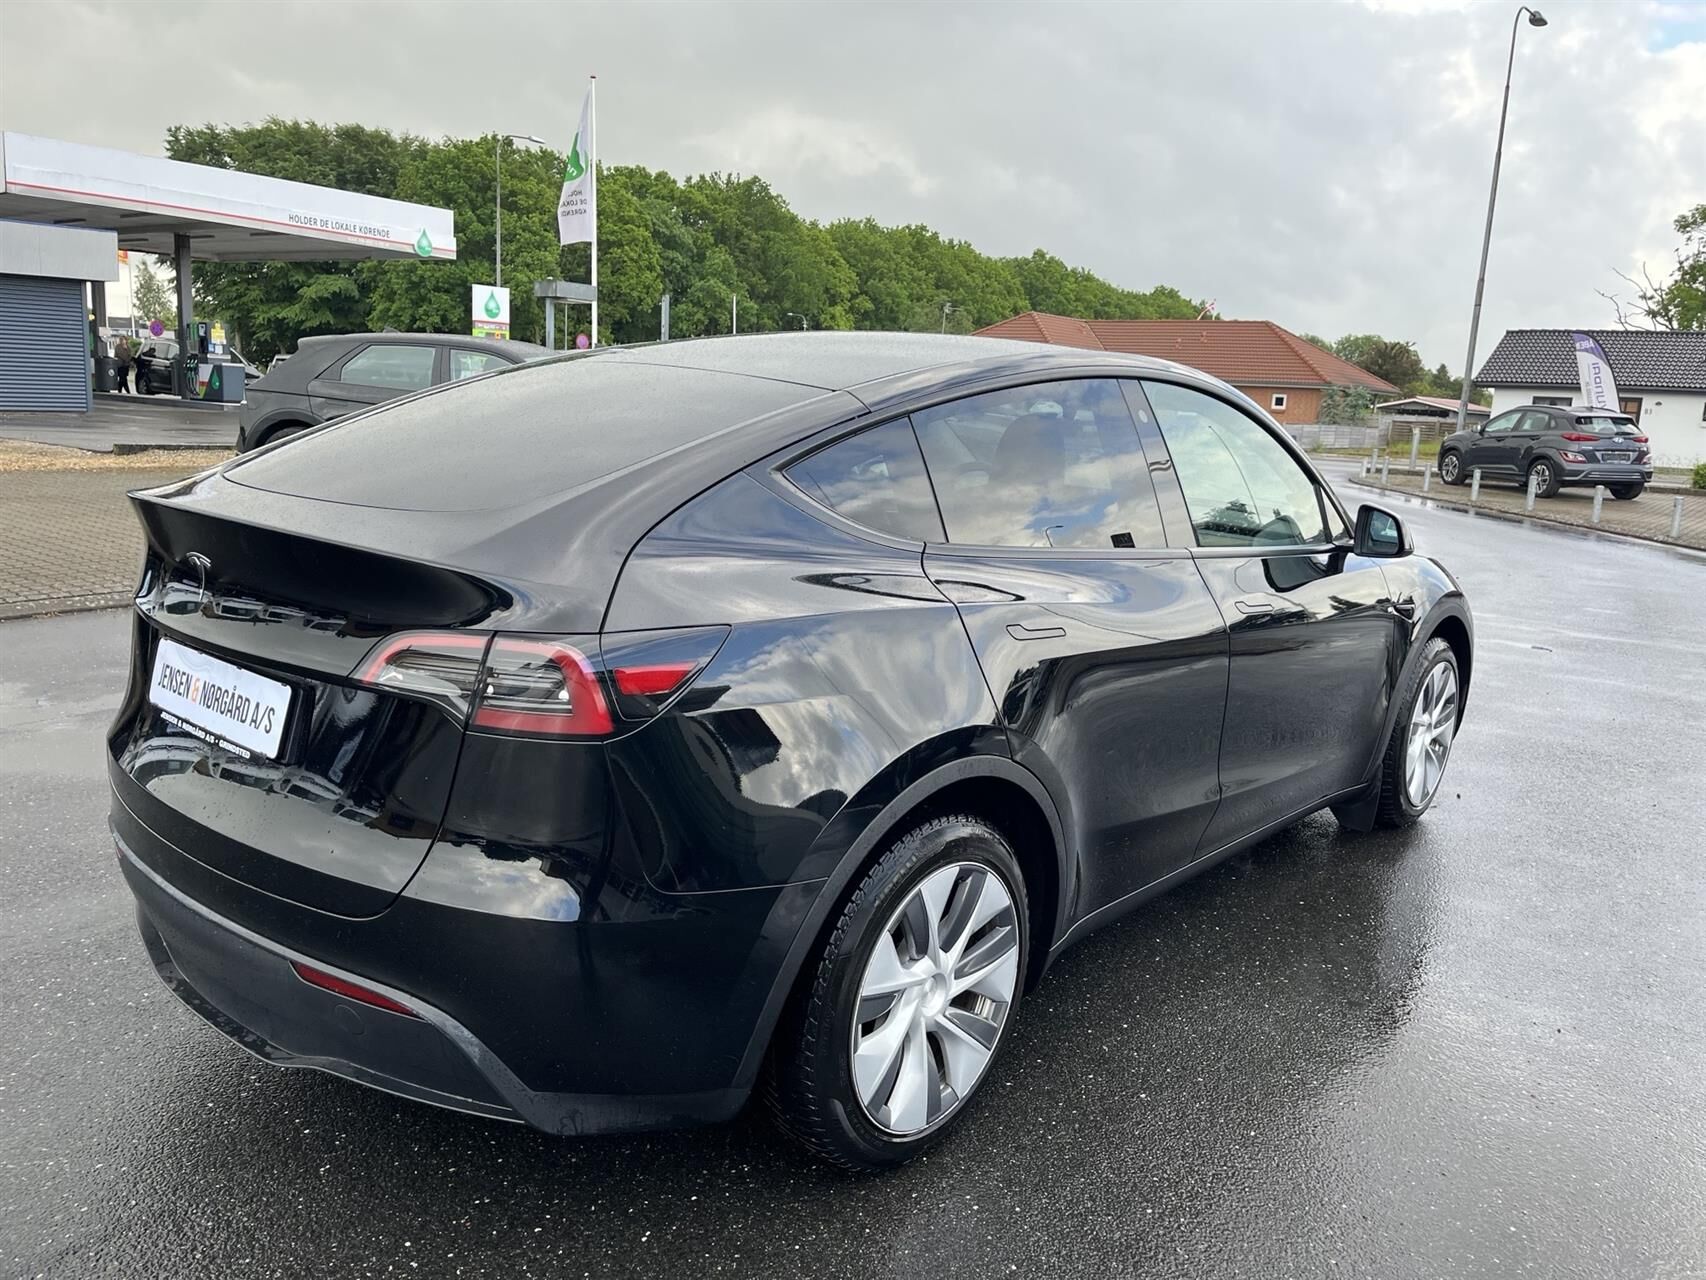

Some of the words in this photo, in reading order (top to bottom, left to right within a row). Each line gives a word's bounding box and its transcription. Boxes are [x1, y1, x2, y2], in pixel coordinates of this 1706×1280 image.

[289, 214, 318, 226] HOLDER
[320, 219, 329, 228] DE
[331, 221, 357, 233] LOKALE
[359, 225, 390, 238] KØRENDE
[158, 663, 193, 699] JENSEN
[191, 678, 200, 702] &
[199, 681, 251, 724] NØRGÅRD
[249, 701, 275, 734] A/S
